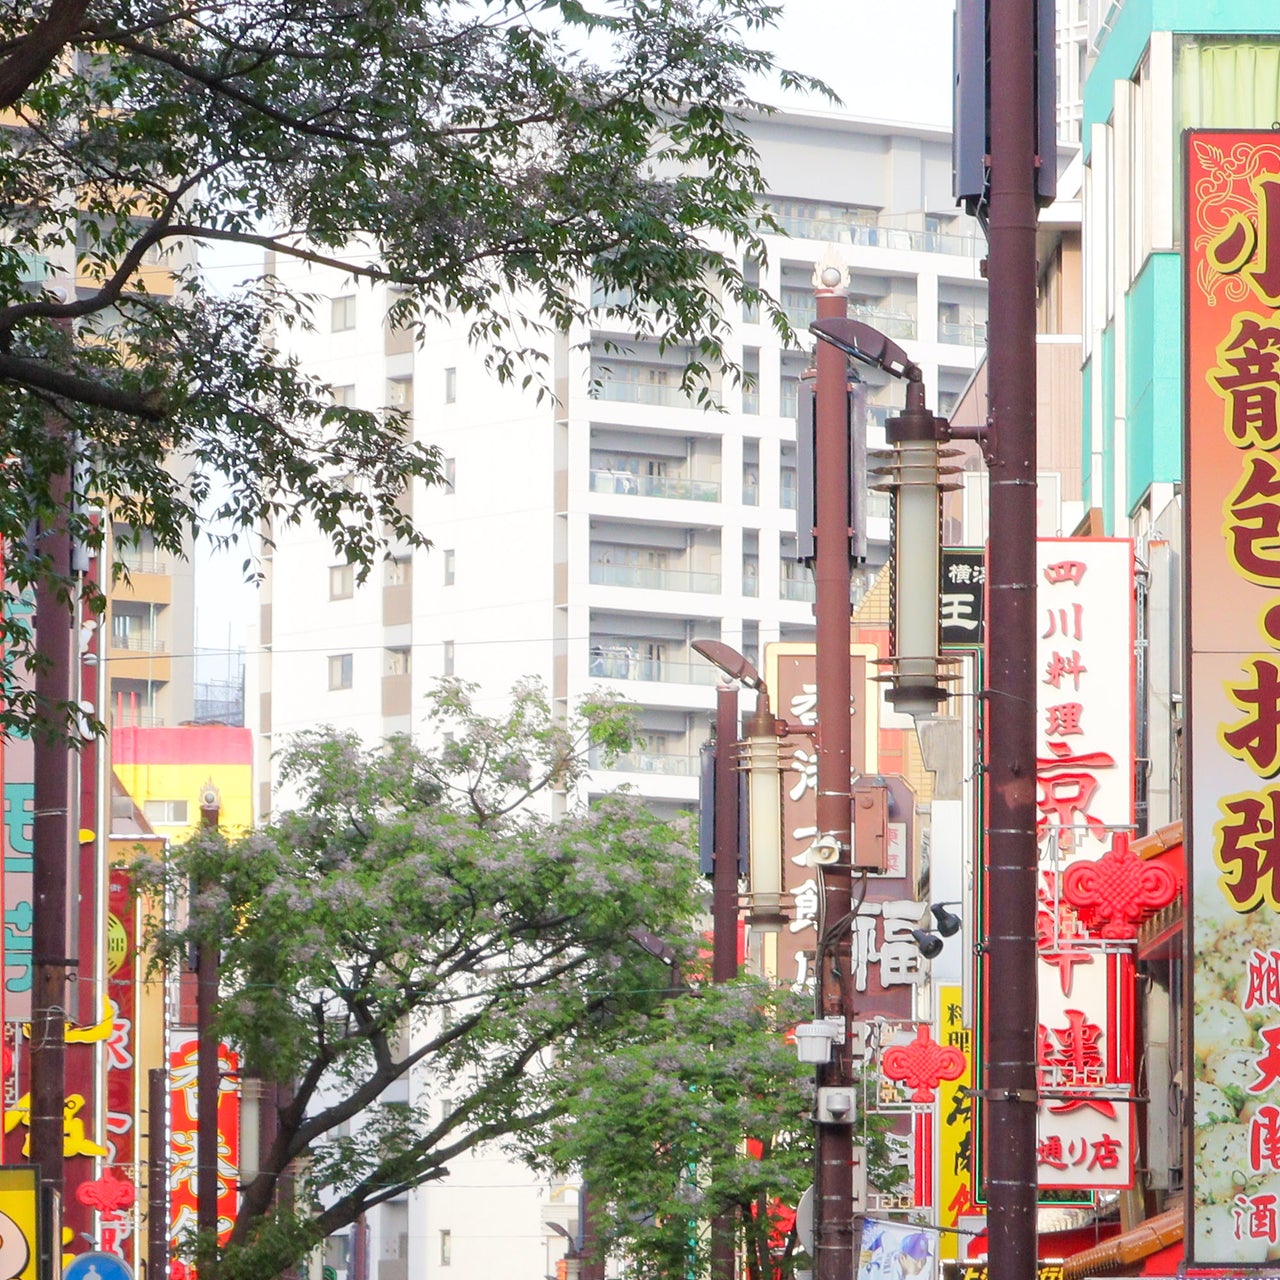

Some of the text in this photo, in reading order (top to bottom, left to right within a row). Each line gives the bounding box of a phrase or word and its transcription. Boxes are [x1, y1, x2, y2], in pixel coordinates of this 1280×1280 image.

[1044, 560, 1087, 736] 四川料理
[851, 900, 927, 992] 福
